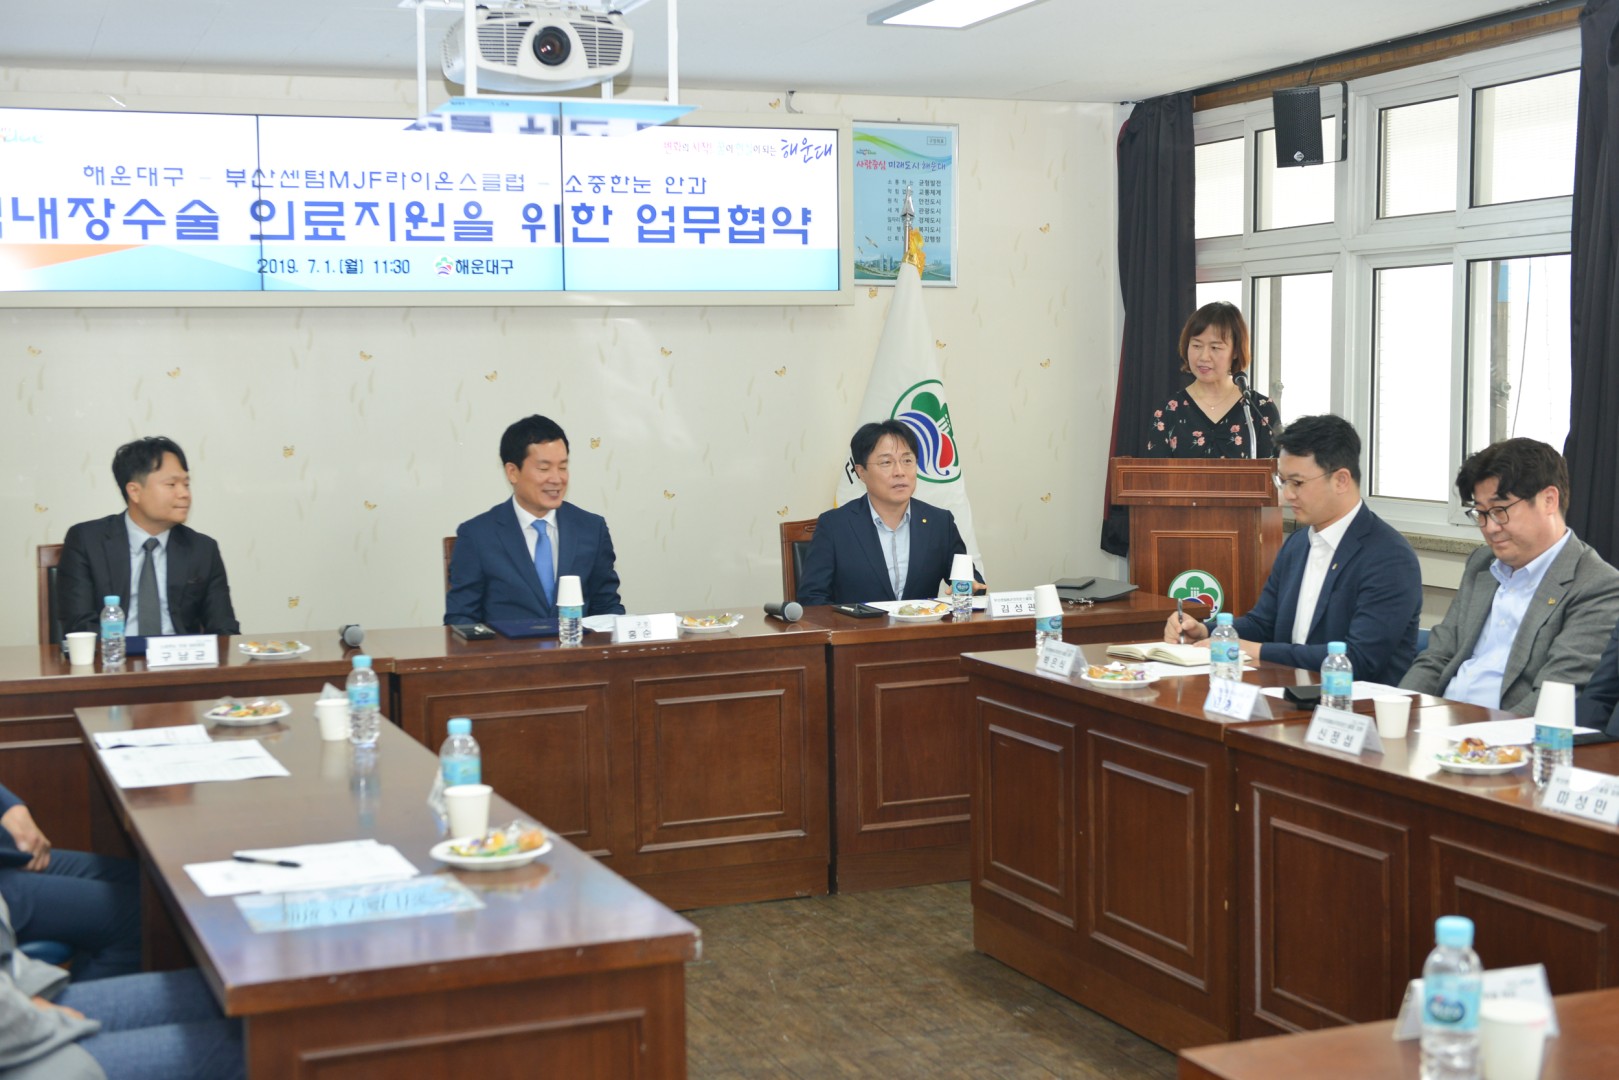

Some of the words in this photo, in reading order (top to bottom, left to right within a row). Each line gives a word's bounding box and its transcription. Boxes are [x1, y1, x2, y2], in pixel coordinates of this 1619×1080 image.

[780, 137, 833, 164] 해운대
[857, 160, 886, 170] 사람중심
[889, 160, 920, 170] 미래도시
[922, 161, 946, 171] 해운대
[83, 165, 184, 187] 해운대구
[225, 168, 525, 192] 부산센텀MJF라이온스클럽
[564, 174, 652, 195] 소중한눈
[665, 175, 707, 195] 안과
[0, 196, 220, 241] 내장수술
[249, 198, 494, 242] 의료지원을
[521, 200, 613, 243] 위한
[636, 203, 812, 246] 업무협약
[256, 258, 298, 275] 2019.
[373, 258, 411, 275] 11:30
[455, 258, 514, 275] 해운대구
